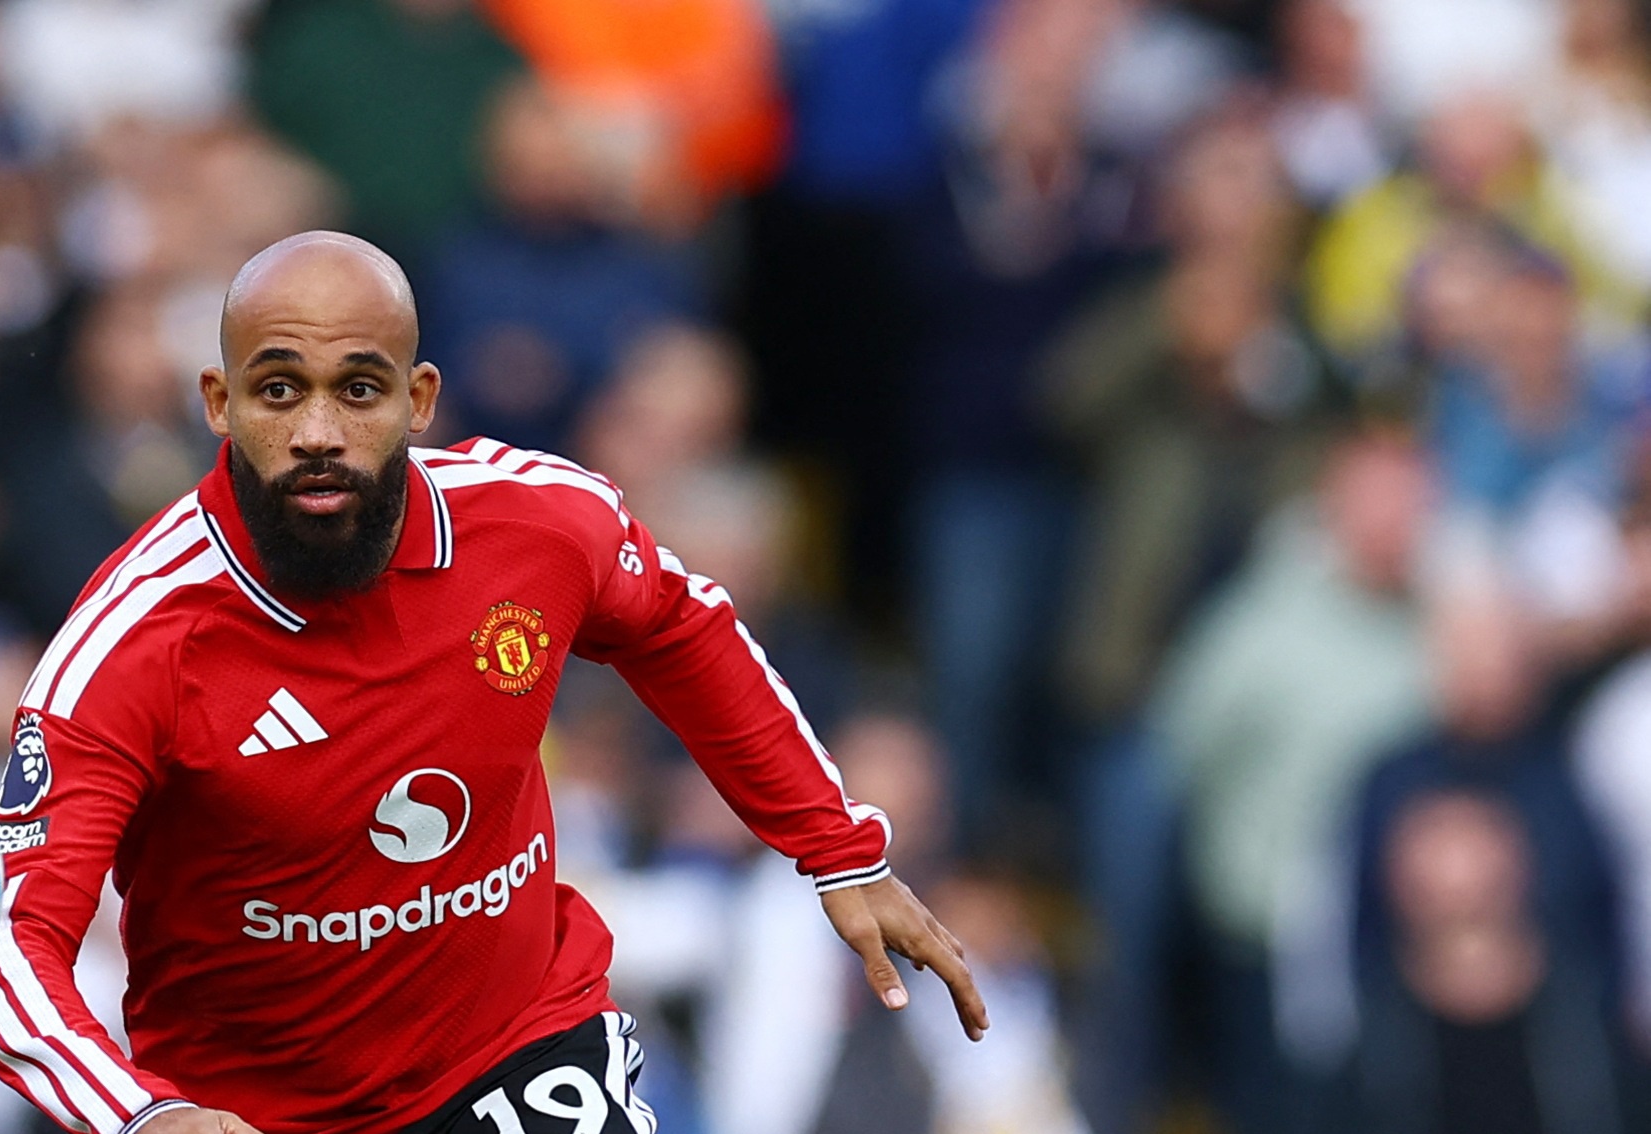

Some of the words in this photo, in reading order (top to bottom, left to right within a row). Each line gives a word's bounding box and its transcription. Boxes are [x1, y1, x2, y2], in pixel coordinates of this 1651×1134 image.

[477, 608, 538, 648] MANCHESTER
[499, 665, 541, 690] UNITED
[243, 832, 548, 952] Snapdragon
